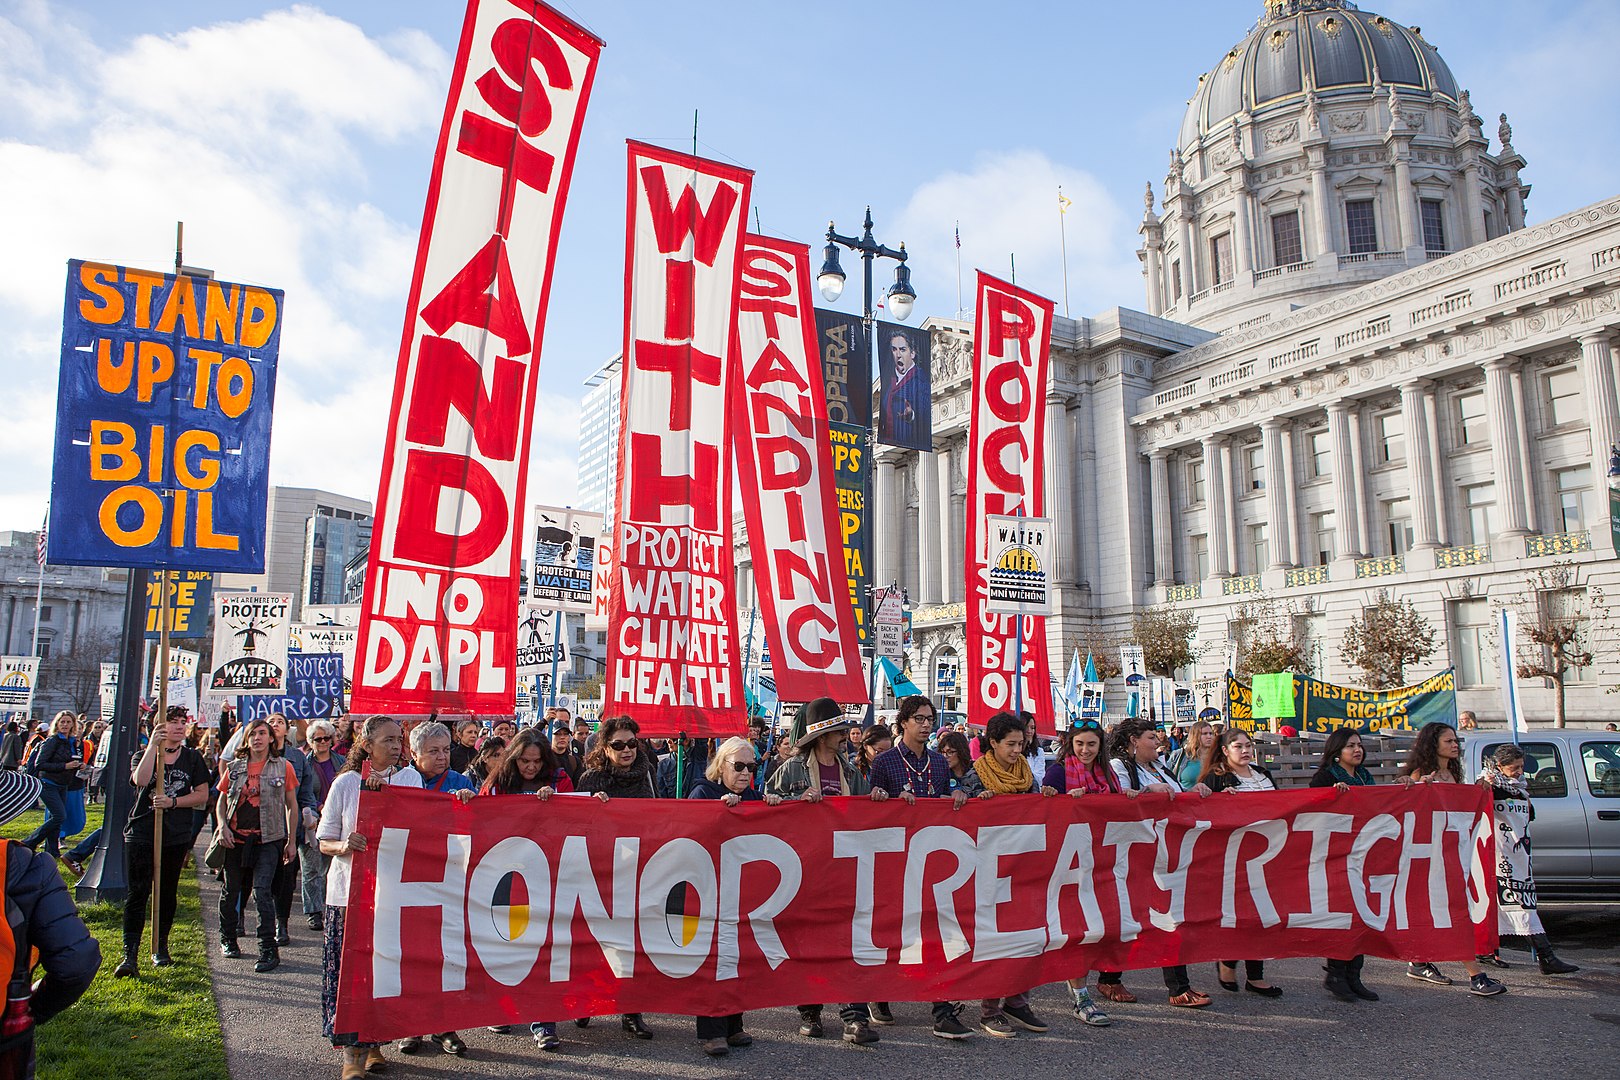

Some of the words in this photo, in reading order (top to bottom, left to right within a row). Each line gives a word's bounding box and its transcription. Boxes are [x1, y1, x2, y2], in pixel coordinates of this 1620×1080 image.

[393, 17, 573, 568] STAND
[80, 261, 277, 349] STAND
[630, 165, 739, 532] WITH
[96, 338, 175, 402] UP
[187, 347, 255, 418] TO
[825, 324, 848, 424] OPERA
[90, 419, 221, 490] BIG
[742, 249, 841, 670] STANDING
[98, 485, 239, 551] OIL
[999, 528, 1043, 546] WATER
[620, 524, 724, 574] PROTECT
[1005, 554, 1032, 570] LIFE
[153, 571, 180, 580] TE
[187, 571, 212, 581] DAPL
[536, 565, 574, 578] PROTECT
[575, 569, 591, 580] THE
[536, 574, 590, 591] WATER
[384, 567, 484, 626] NO
[534, 588, 559, 597] DEFEND
[560, 590, 572, 599] THE
[573, 591, 591, 600] LAND
[222, 604, 287, 618] PROTECT
[309, 631, 354, 641] WATER
[361, 619, 506, 694] DAPL
[518, 650, 563, 665] ROUND
[5, 663, 32, 672] WATER
[223, 663, 277, 678] WATER
[7, 678, 24, 686] LIFE
[232, 676, 240, 684] IS
[242, 676, 262, 684] LIFE
[295, 678, 341, 696] THE
[614, 658, 732, 709] HEALTH
[1194, 681, 1219, 690] PROTECT
[1312, 681, 1380, 702] RESPECT
[1346, 699, 1410, 719] RIGHTS
[1316, 717, 1365, 733] STOP
[373, 826, 803, 1000] HONOR
[831, 817, 1212, 967] TREATY
[1220, 809, 1494, 932] RIGHTS
